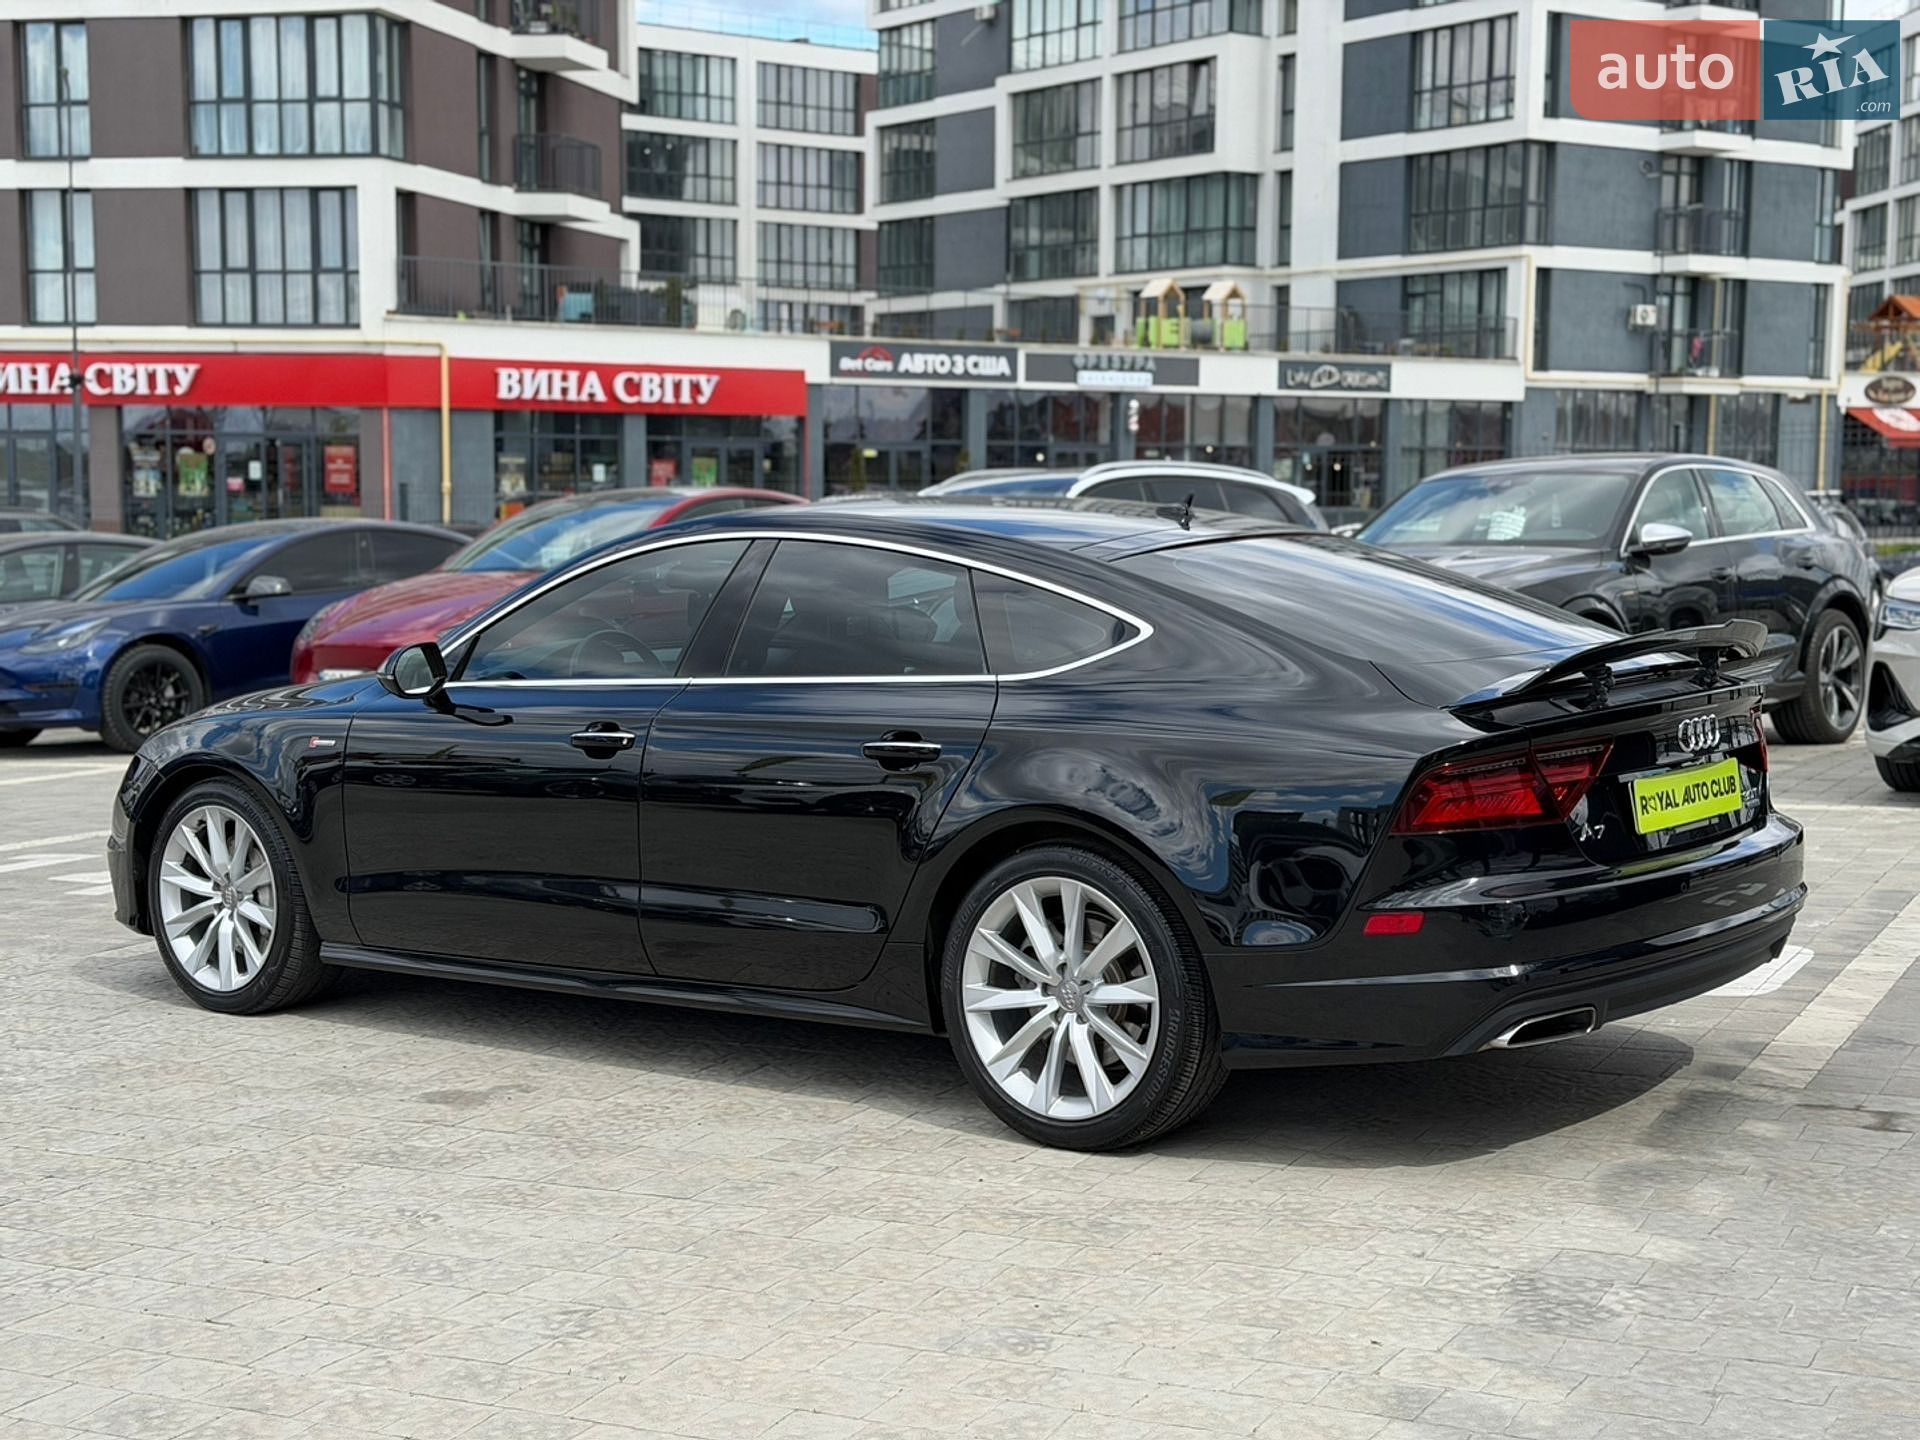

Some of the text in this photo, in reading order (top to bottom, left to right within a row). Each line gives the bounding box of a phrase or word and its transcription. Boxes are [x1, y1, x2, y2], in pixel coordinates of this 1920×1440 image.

[84, 362, 201, 396] СВІТУ
[898, 352, 950, 375] АВТО
[966, 355, 1012, 377] США
[496, 367, 721, 405] ВИНА СВІТУ
[1682, 781, 1709, 806] AUTO
[1711, 775, 1737, 798] CLUB
